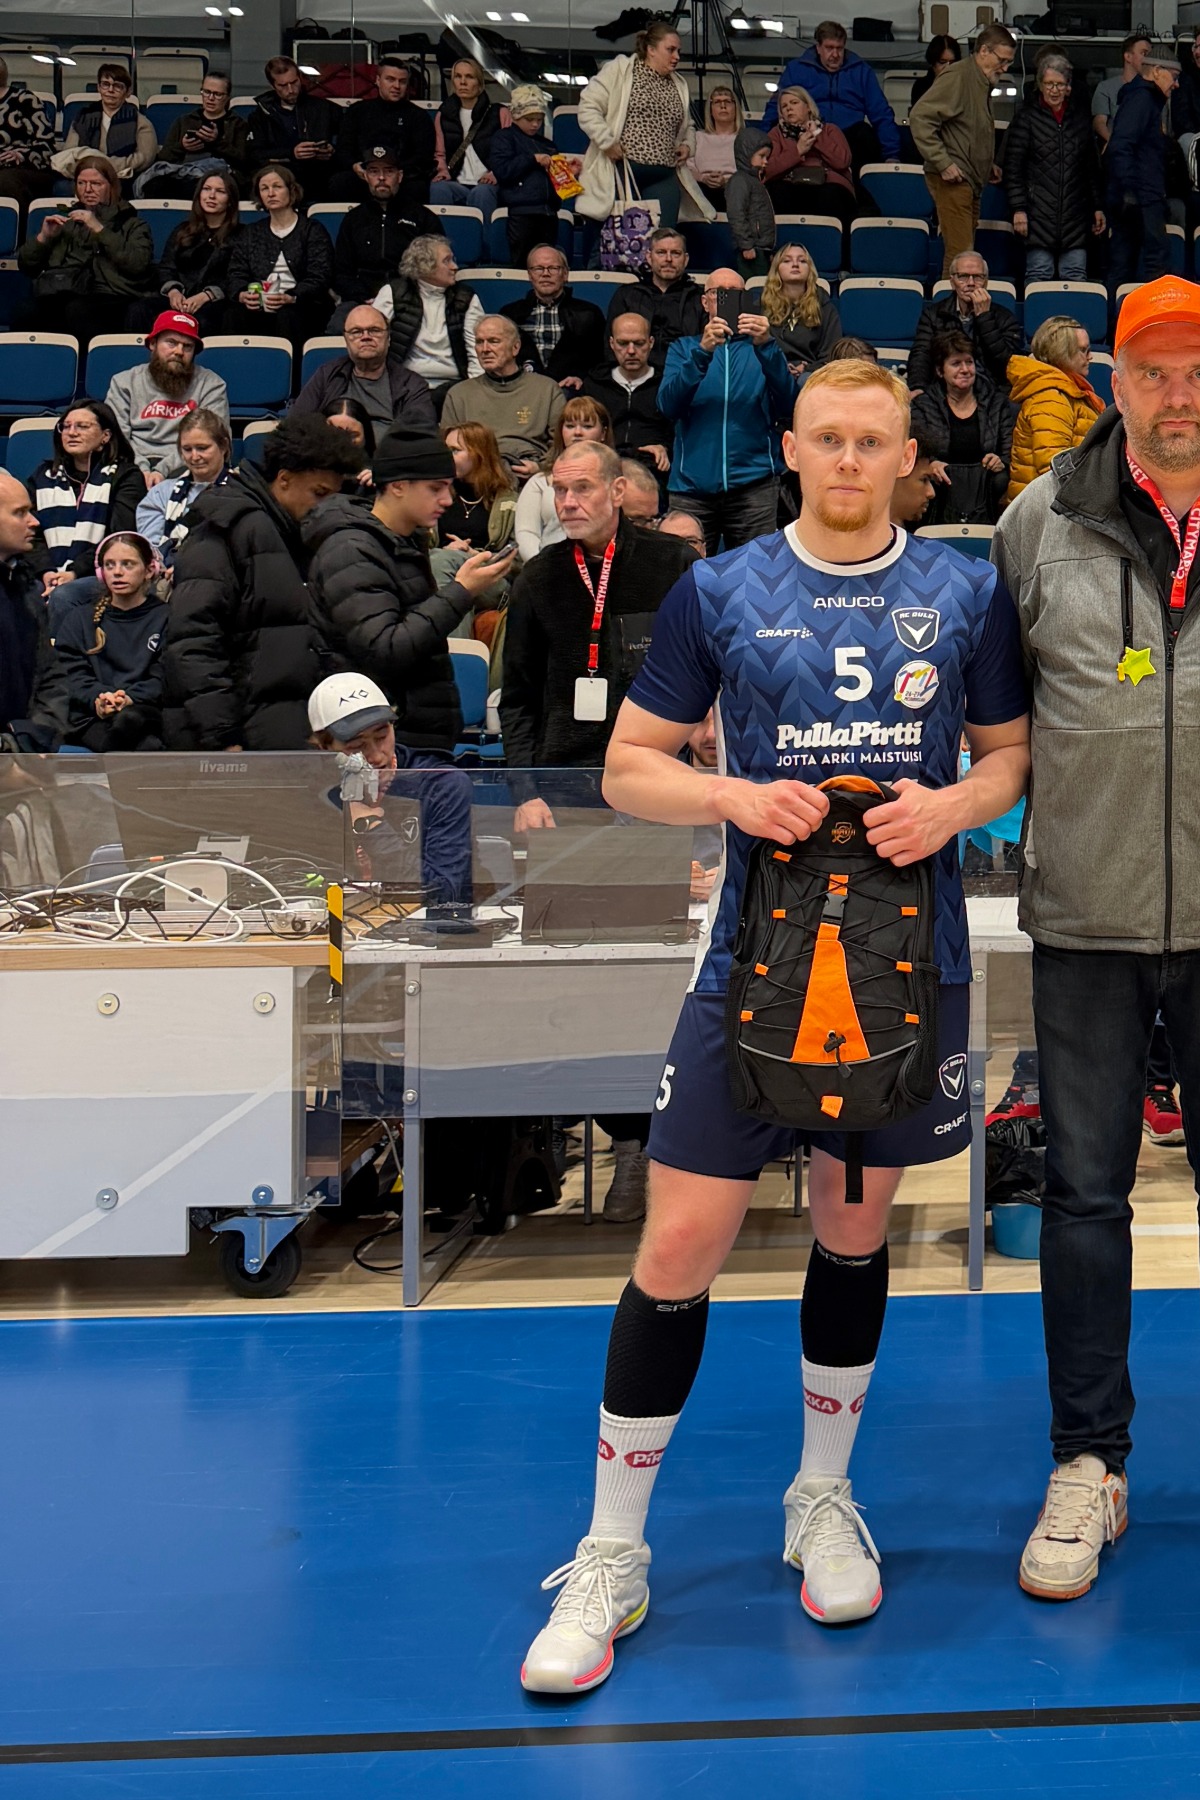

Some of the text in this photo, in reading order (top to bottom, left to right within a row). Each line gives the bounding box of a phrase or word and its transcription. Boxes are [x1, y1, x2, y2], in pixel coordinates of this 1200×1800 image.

[813, 596, 885, 609] ANUCO
[755, 628, 801, 639] CRAFT
[834, 646, 873, 702] 5
[776, 721, 923, 750] PullaPirtti
[776, 750, 923, 767] JOTTA ARKI MAISTUISI
[655, 1064, 675, 1111] 5
